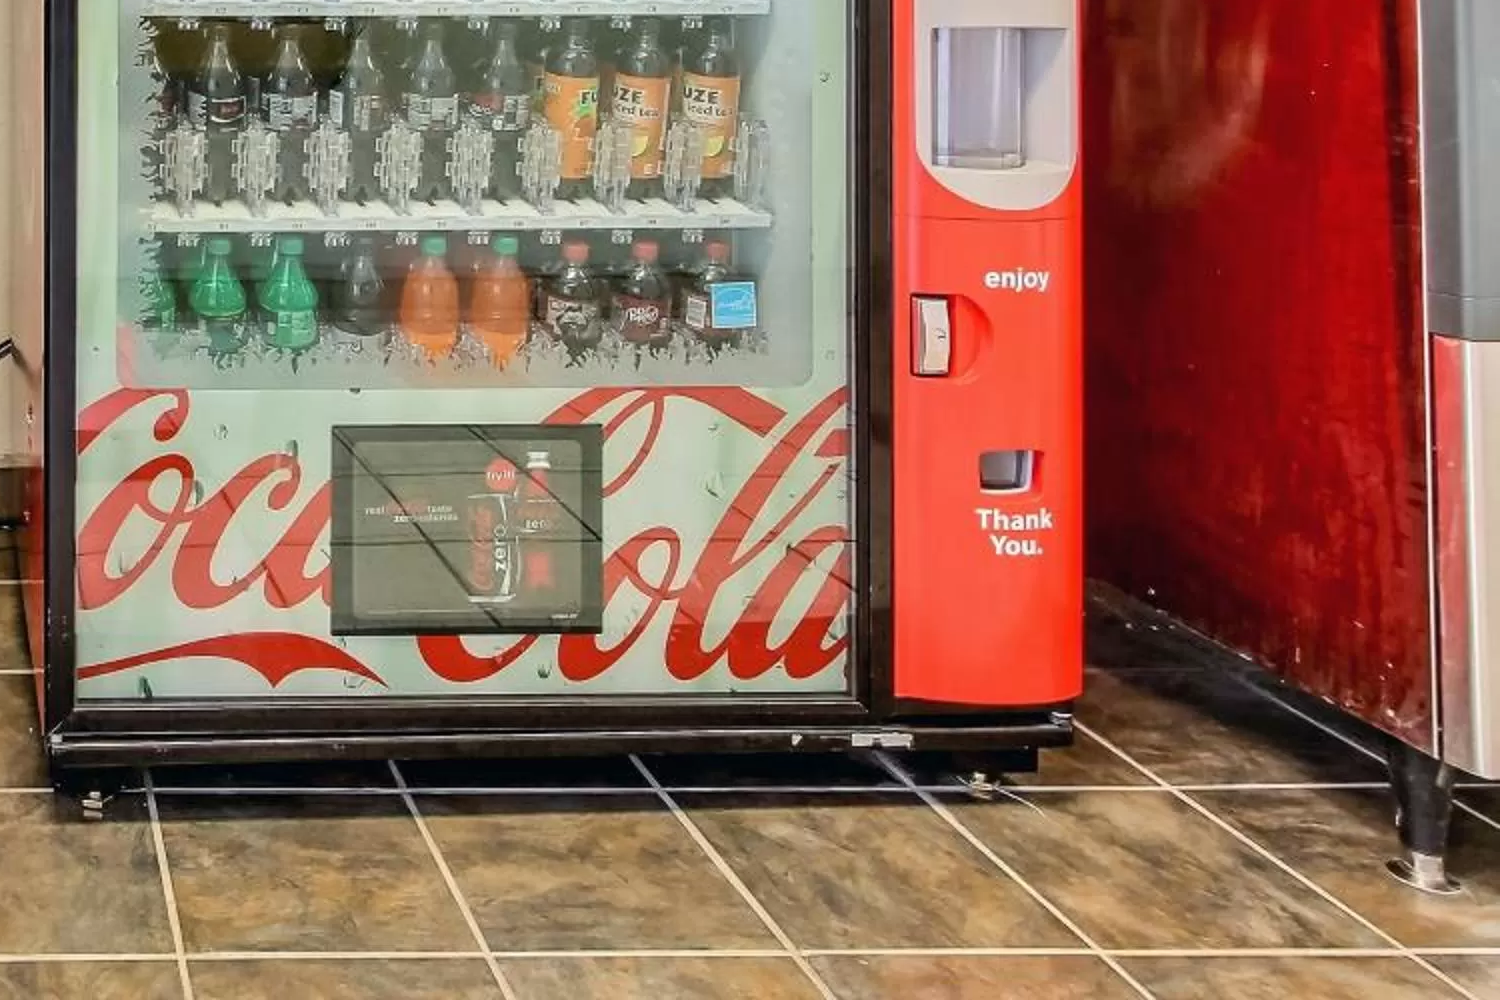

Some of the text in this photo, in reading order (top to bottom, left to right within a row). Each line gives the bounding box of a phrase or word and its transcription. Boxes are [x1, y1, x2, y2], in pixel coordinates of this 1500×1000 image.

[984, 268, 1050, 293] enjoy
[974, 507, 1053, 530] Thank
[493, 522, 508, 573] zero
[989, 534, 1044, 556] You.
